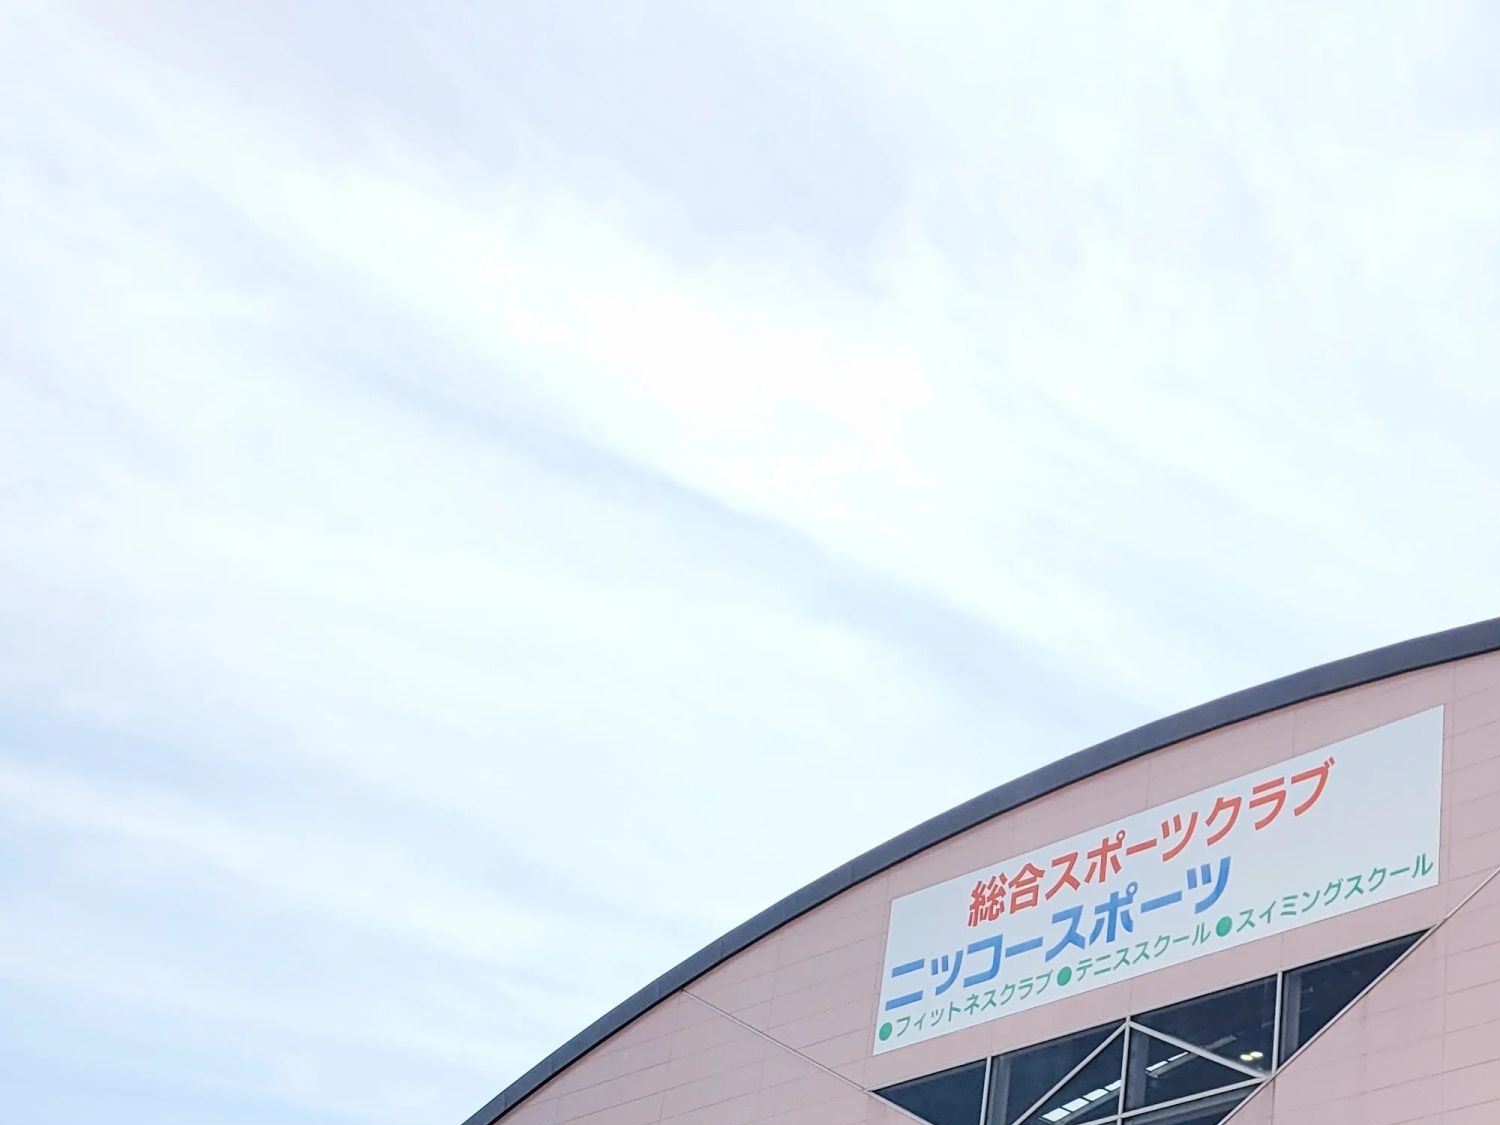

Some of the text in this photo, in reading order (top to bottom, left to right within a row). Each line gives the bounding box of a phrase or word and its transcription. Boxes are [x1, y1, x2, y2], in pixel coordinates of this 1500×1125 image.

[967, 756, 1336, 927] 総合スポーツクラブ
[885, 856, 1232, 1012] ニッコースポーツ
[896, 853, 1434, 1038] フィットネスクラブ テニススクール スイミングスクール
